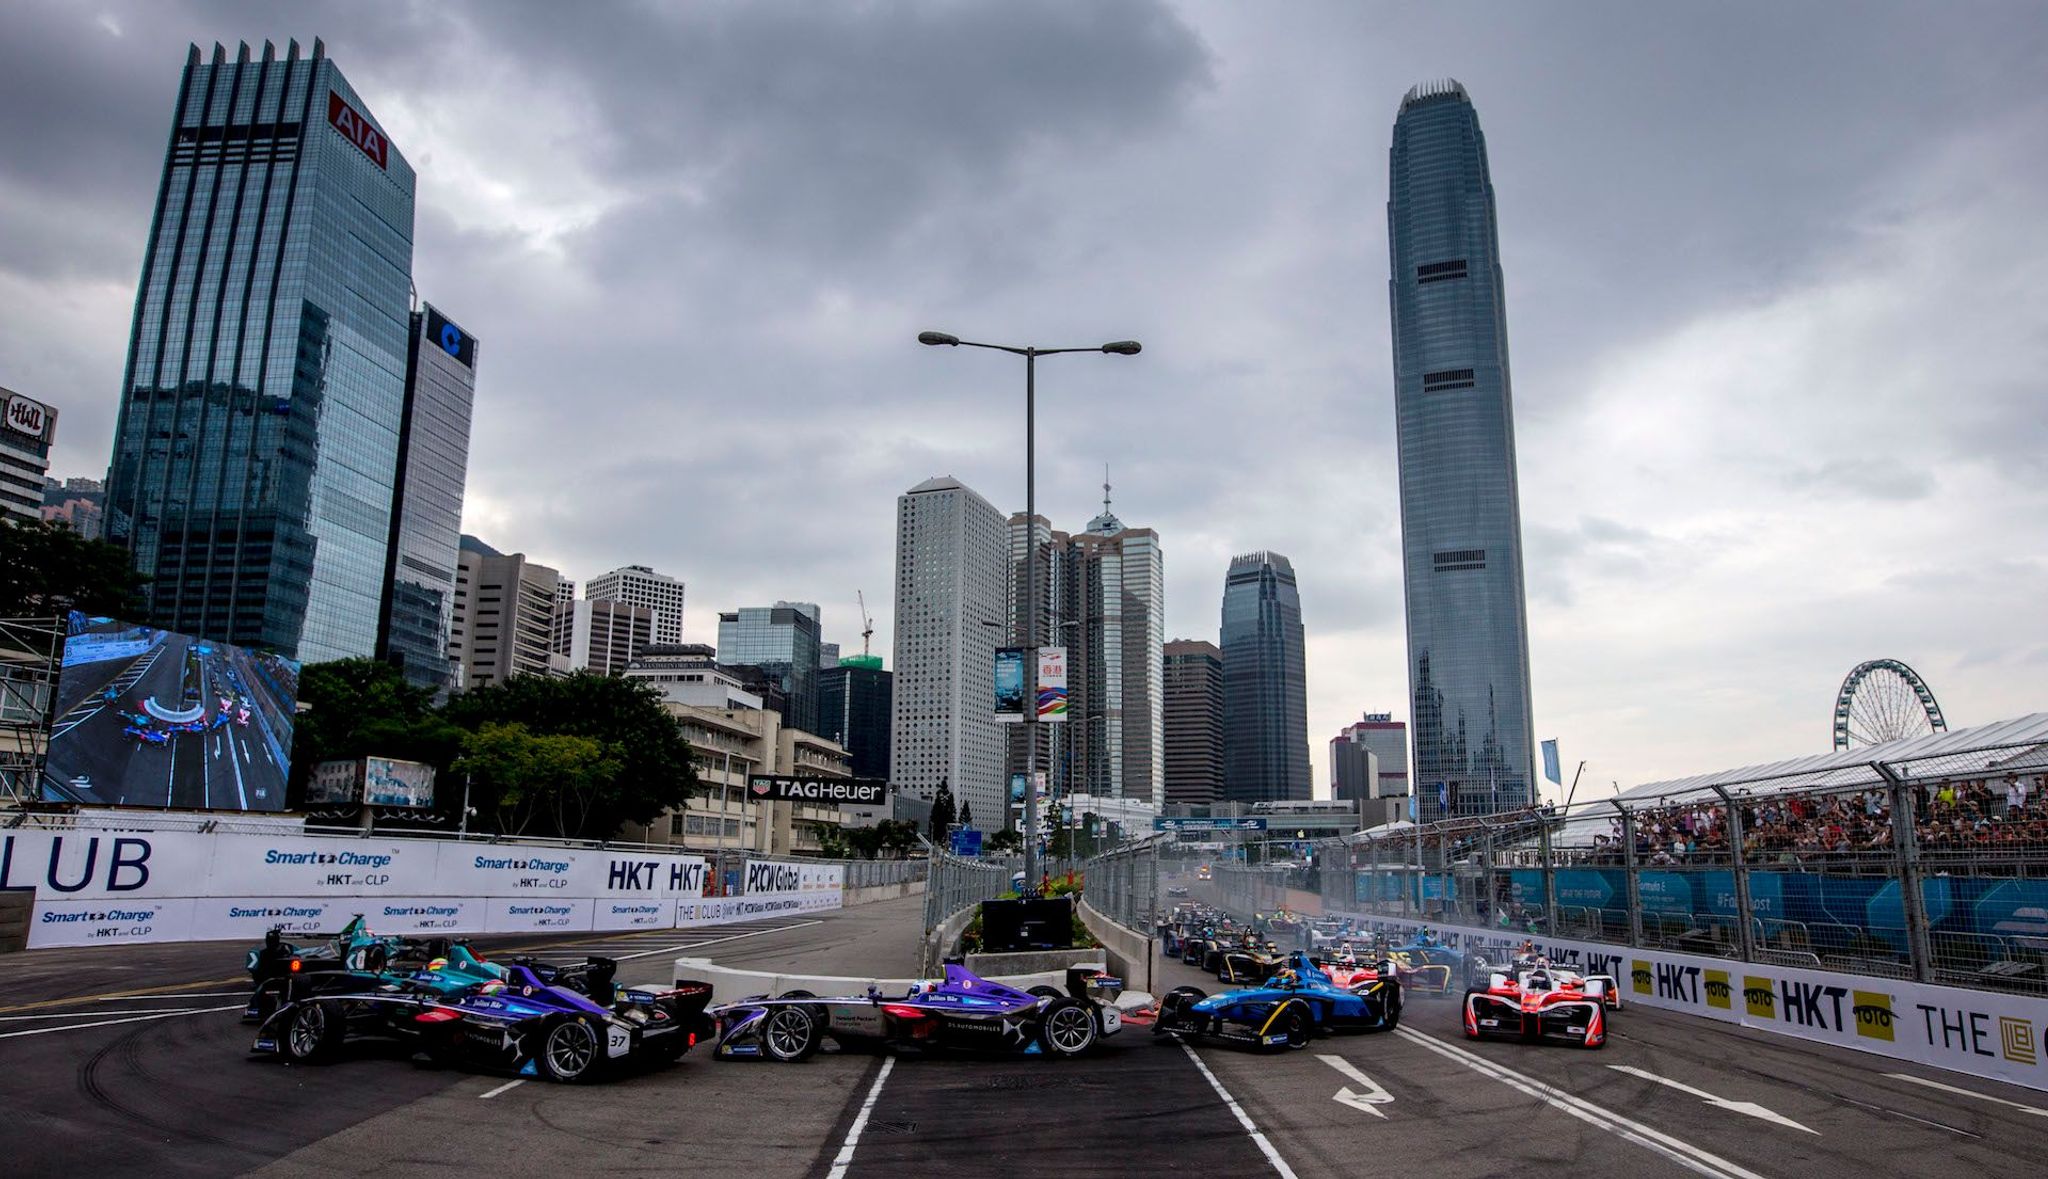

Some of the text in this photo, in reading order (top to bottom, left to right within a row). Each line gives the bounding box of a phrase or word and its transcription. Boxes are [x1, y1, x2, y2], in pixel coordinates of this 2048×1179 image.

[336, 105, 381, 161] AIA
[0, 836, 152, 892] LUB
[265, 850, 317, 865] Smart
[338, 852, 391, 868] Charge
[474, 856, 513, 869] Smart
[528, 858, 569, 873] Charge
[326, 875, 352, 885] HKT
[365, 874, 390, 885] CLP
[608, 860, 702, 891] HKT HKT
[747, 863, 776, 892] PCCW
[775, 865, 800, 891] Global
[520, 878, 540, 888] HKT
[549, 879, 568, 888] CLP
[42, 911, 88, 923] Smart
[107, 910, 154, 922] Charge
[229, 907, 267, 918] Smart
[282, 906, 323, 918] Charge
[383, 906, 459, 916] Smart Charge
[508, 906, 571, 915] Smart Charge
[679, 906, 694, 919] THE
[701, 904, 721, 919] CLUB
[274, 923, 292, 931] HKT
[302, 922, 321, 931] CLP
[442, 920, 458, 928] CLP
[96, 928, 119, 938] HKT
[130, 927, 152, 936] CLP
[1588, 952, 1623, 988] HKT
[1656, 962, 1701, 1003] HKT
[1781, 980, 1848, 1032] HKT
[1108, 1014, 1115, 1025] 2
[1916, 1004, 1995, 1057] THE
[609, 1035, 626, 1047] 37
